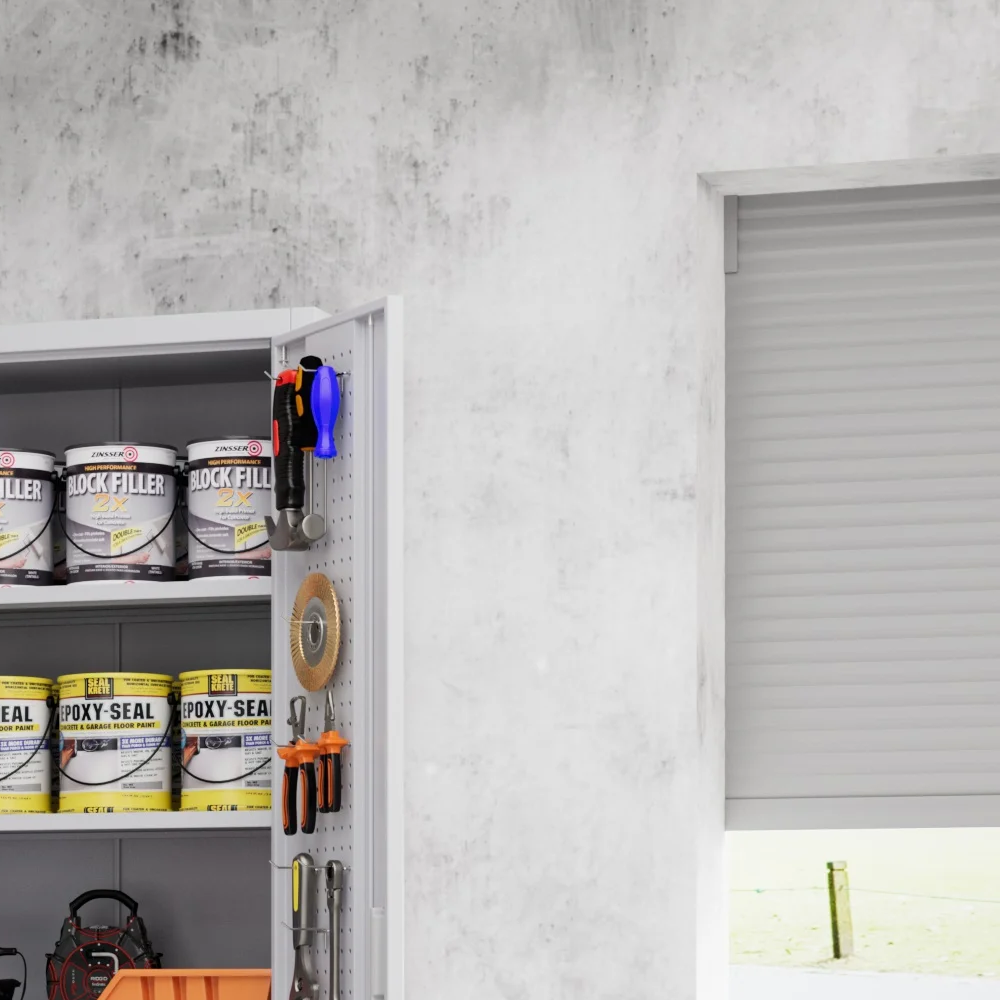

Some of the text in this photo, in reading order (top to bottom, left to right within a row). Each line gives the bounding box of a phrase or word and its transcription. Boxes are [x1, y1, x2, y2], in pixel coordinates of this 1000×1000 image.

[68, 473, 165, 497] BLOCK FILLER
[190, 467, 271, 491] BLOCK FILL
[113, 528, 133, 541] DOUBLE
[237, 524, 257, 536] DOUBLE
[88, 678, 110, 686] SEAL
[211, 675, 233, 684] SEAL
[88, 686, 110, 695] KRETE
[61, 703, 154, 722] EPOXY-SEAL
